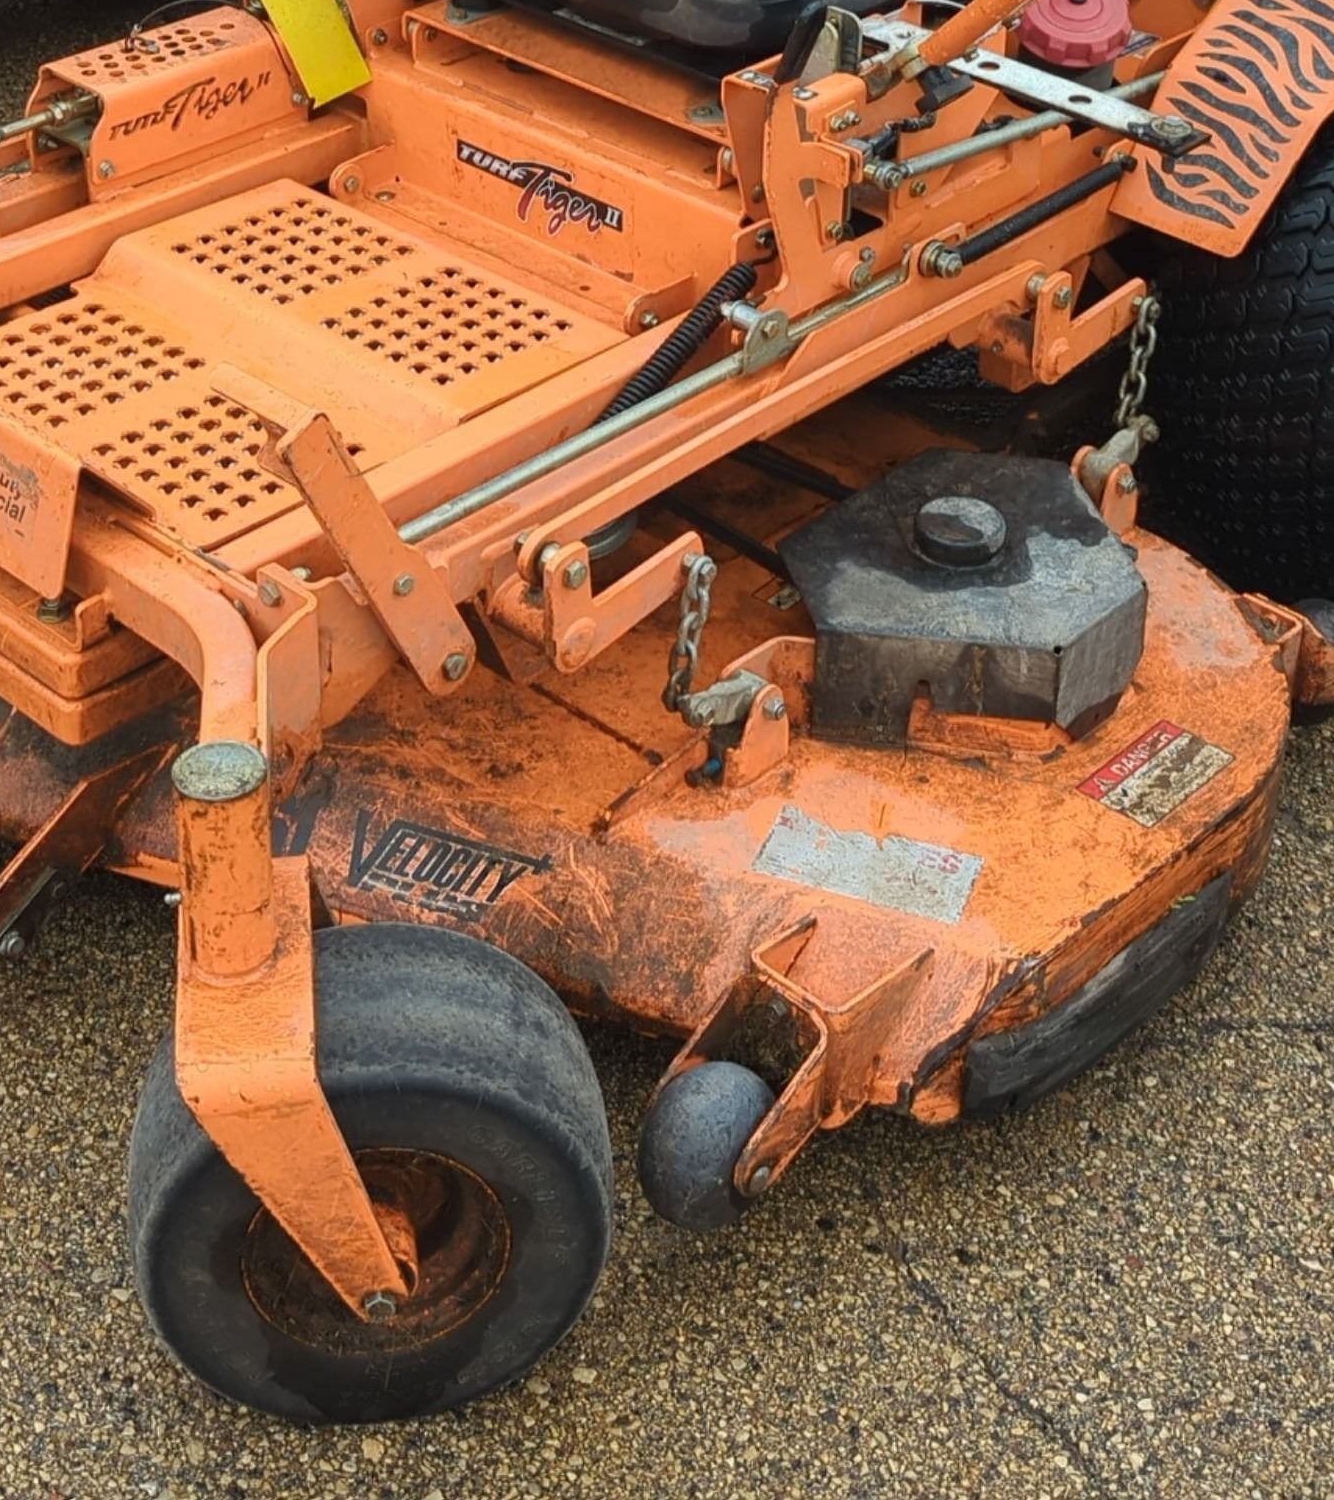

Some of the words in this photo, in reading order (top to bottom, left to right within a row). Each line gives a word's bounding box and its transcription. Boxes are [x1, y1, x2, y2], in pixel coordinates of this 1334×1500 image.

[459, 143, 528, 183] TURF
[508, 159, 603, 236] Tiger
[603, 205, 622, 228] II
[347, 809, 531, 905] VELOCITY
